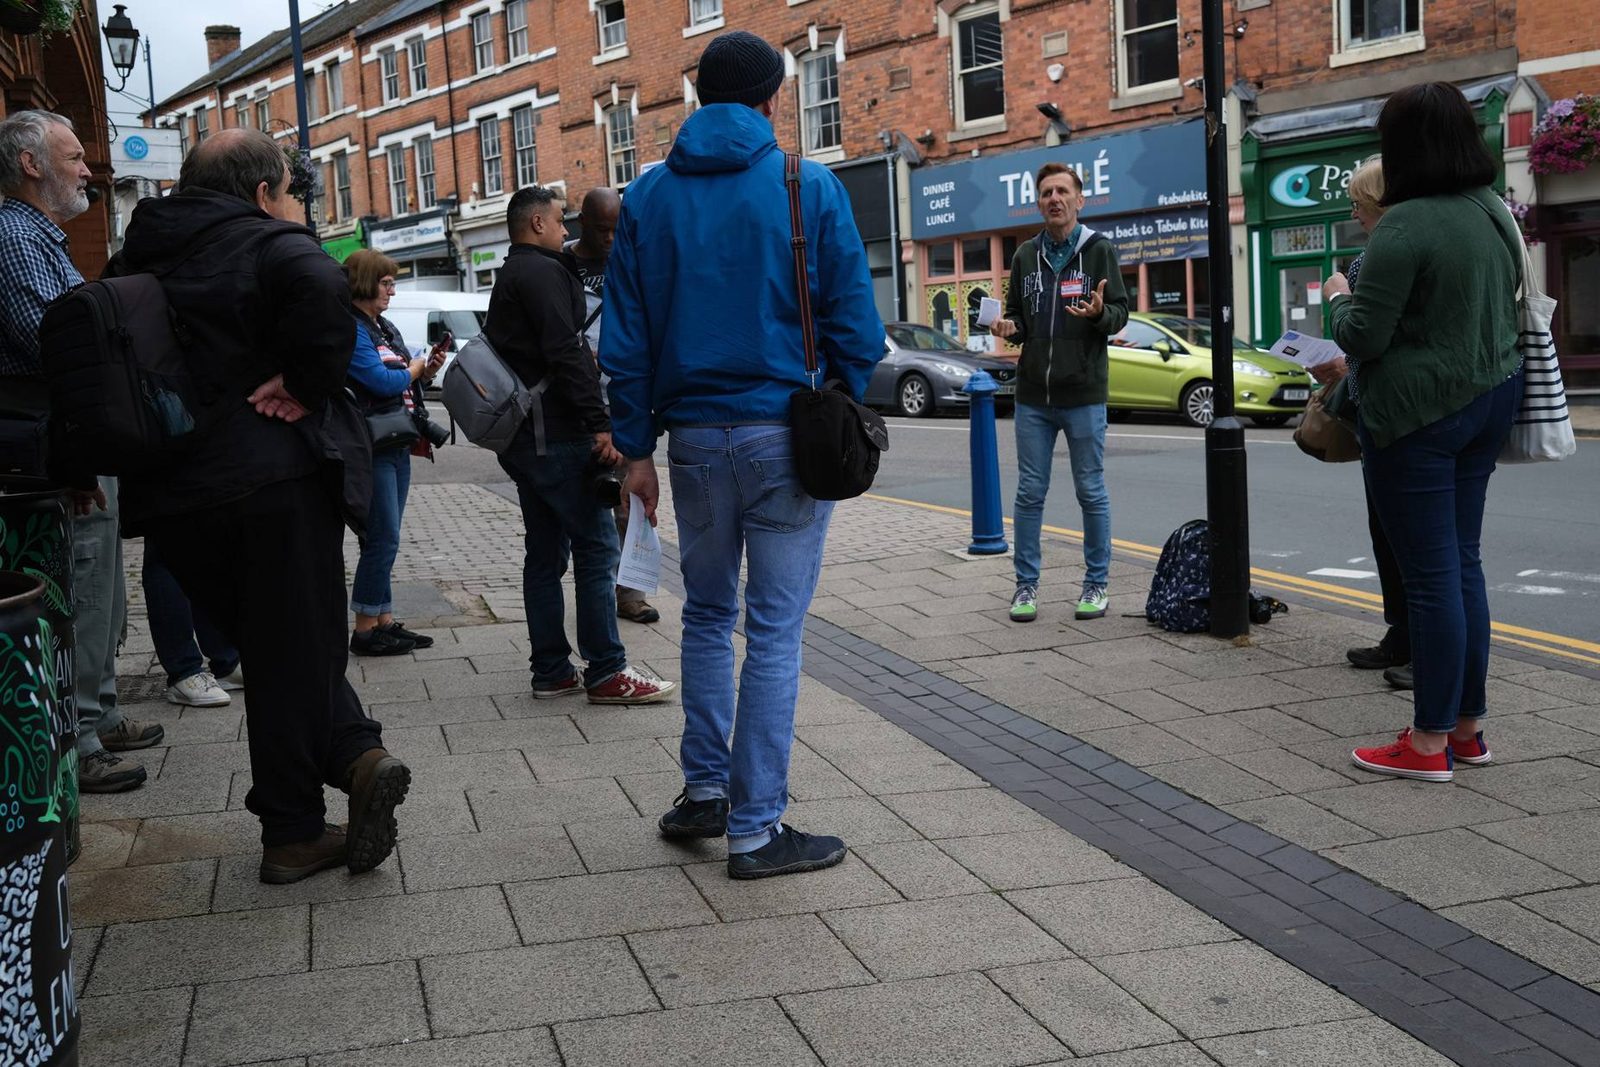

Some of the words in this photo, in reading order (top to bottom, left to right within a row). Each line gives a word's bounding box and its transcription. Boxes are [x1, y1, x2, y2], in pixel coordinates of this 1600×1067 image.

[1000, 149, 1111, 207] TALÉ
[922, 181, 955, 197] DINNER
[929, 196, 951, 210] CAFÉ
[926, 212, 955, 226] LUNCH
[1115, 223, 1140, 239] back
[1141, 225, 1154, 236] to
[1155, 218, 1188, 234] Tabule
